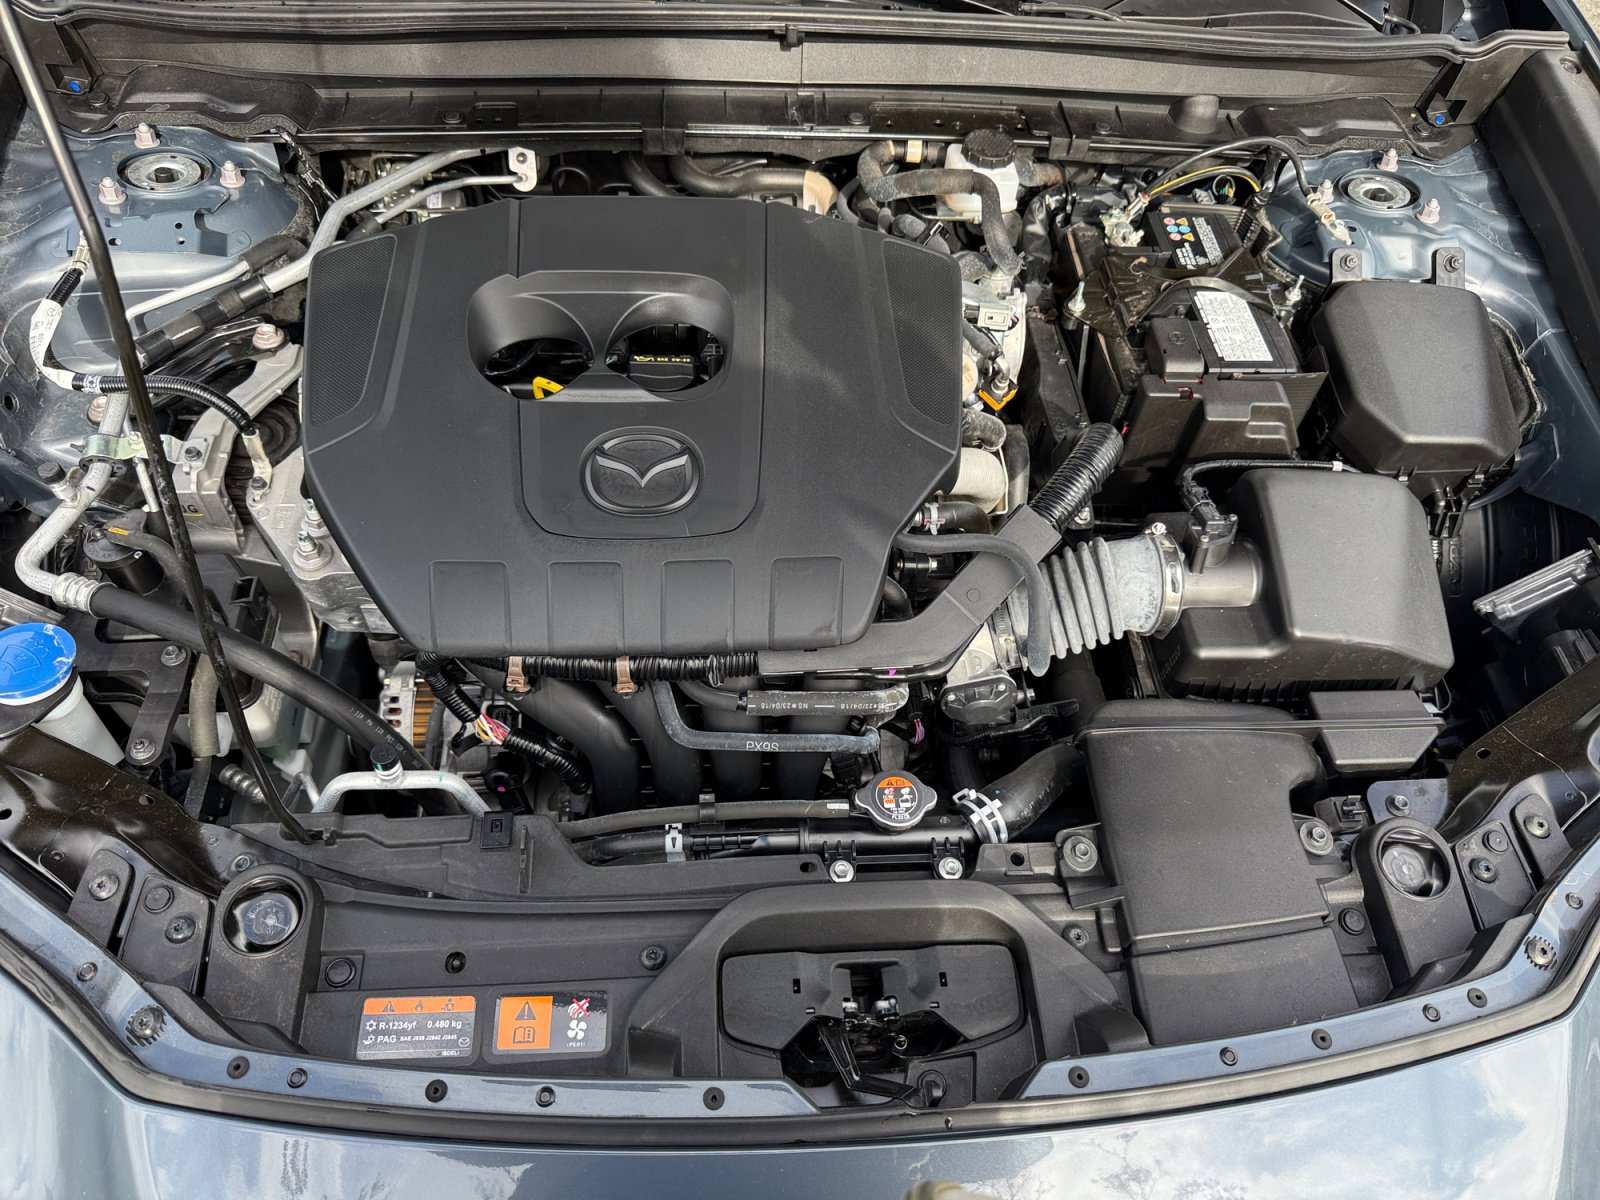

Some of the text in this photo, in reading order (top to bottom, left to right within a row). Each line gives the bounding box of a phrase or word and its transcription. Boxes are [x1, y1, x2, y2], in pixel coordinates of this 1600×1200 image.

[745, 740, 779, 751] PX9S
[378, 1020, 462, 1031] R-1234yf 0.480 kg
[377, 1035, 397, 1043] PAG
